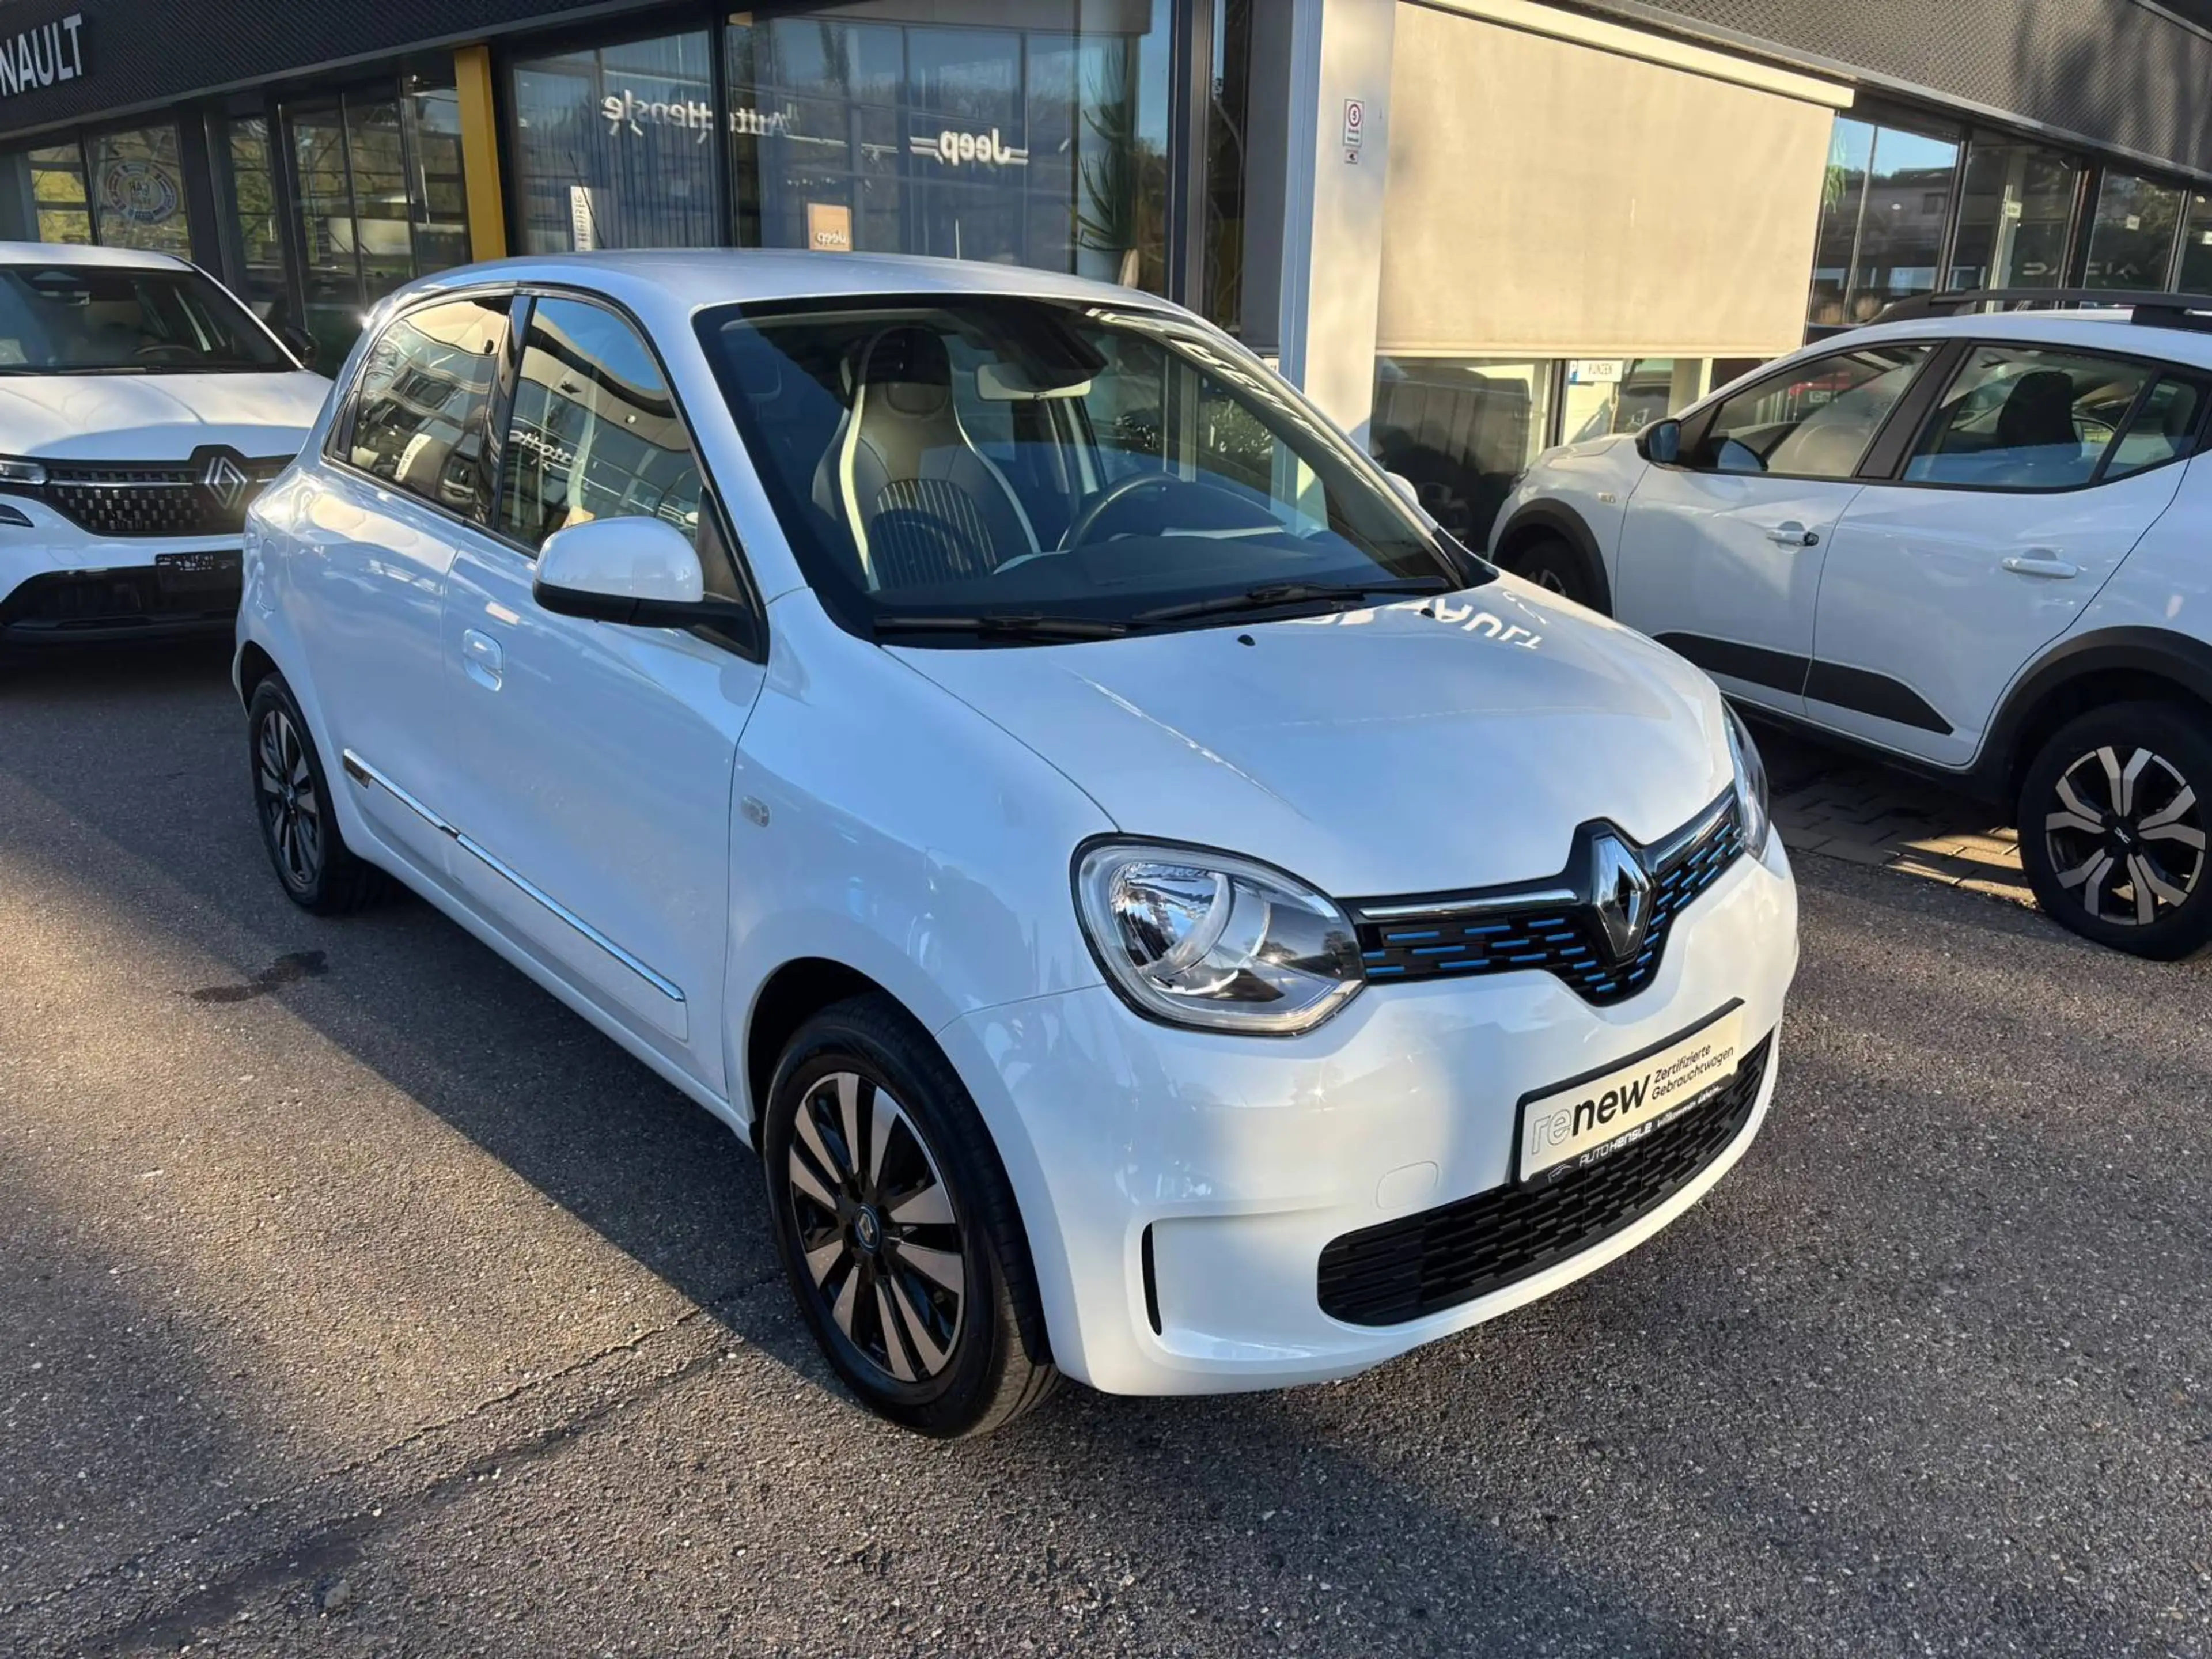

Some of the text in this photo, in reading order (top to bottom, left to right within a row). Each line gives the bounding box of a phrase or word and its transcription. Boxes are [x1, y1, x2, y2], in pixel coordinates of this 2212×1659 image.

[1652, 1046, 1734, 1100] Gebrauchtwagen
[1654, 1044, 1711, 1084] Zertifizierte
[1532, 1074, 1651, 1156] renew
[1579, 1144, 1609, 1168] AUTO
